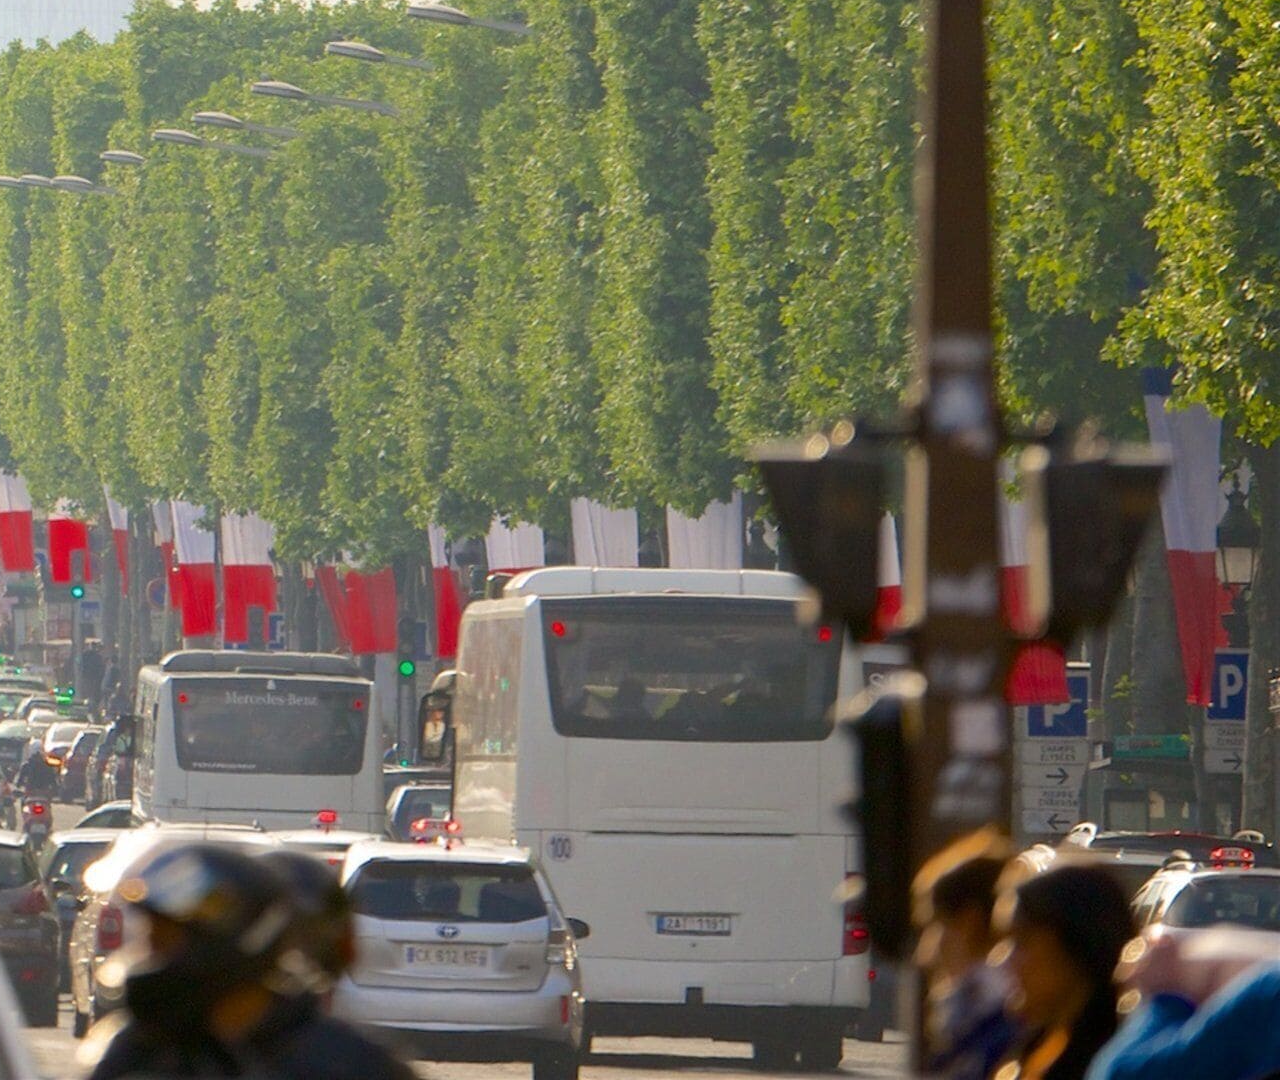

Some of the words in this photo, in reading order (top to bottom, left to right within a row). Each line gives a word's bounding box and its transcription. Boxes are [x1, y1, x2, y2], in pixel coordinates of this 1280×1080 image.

[1219, 664, 1243, 708] P
[225, 691, 320, 706] Mercedes-Benz
[551, 836, 572, 858] 100
